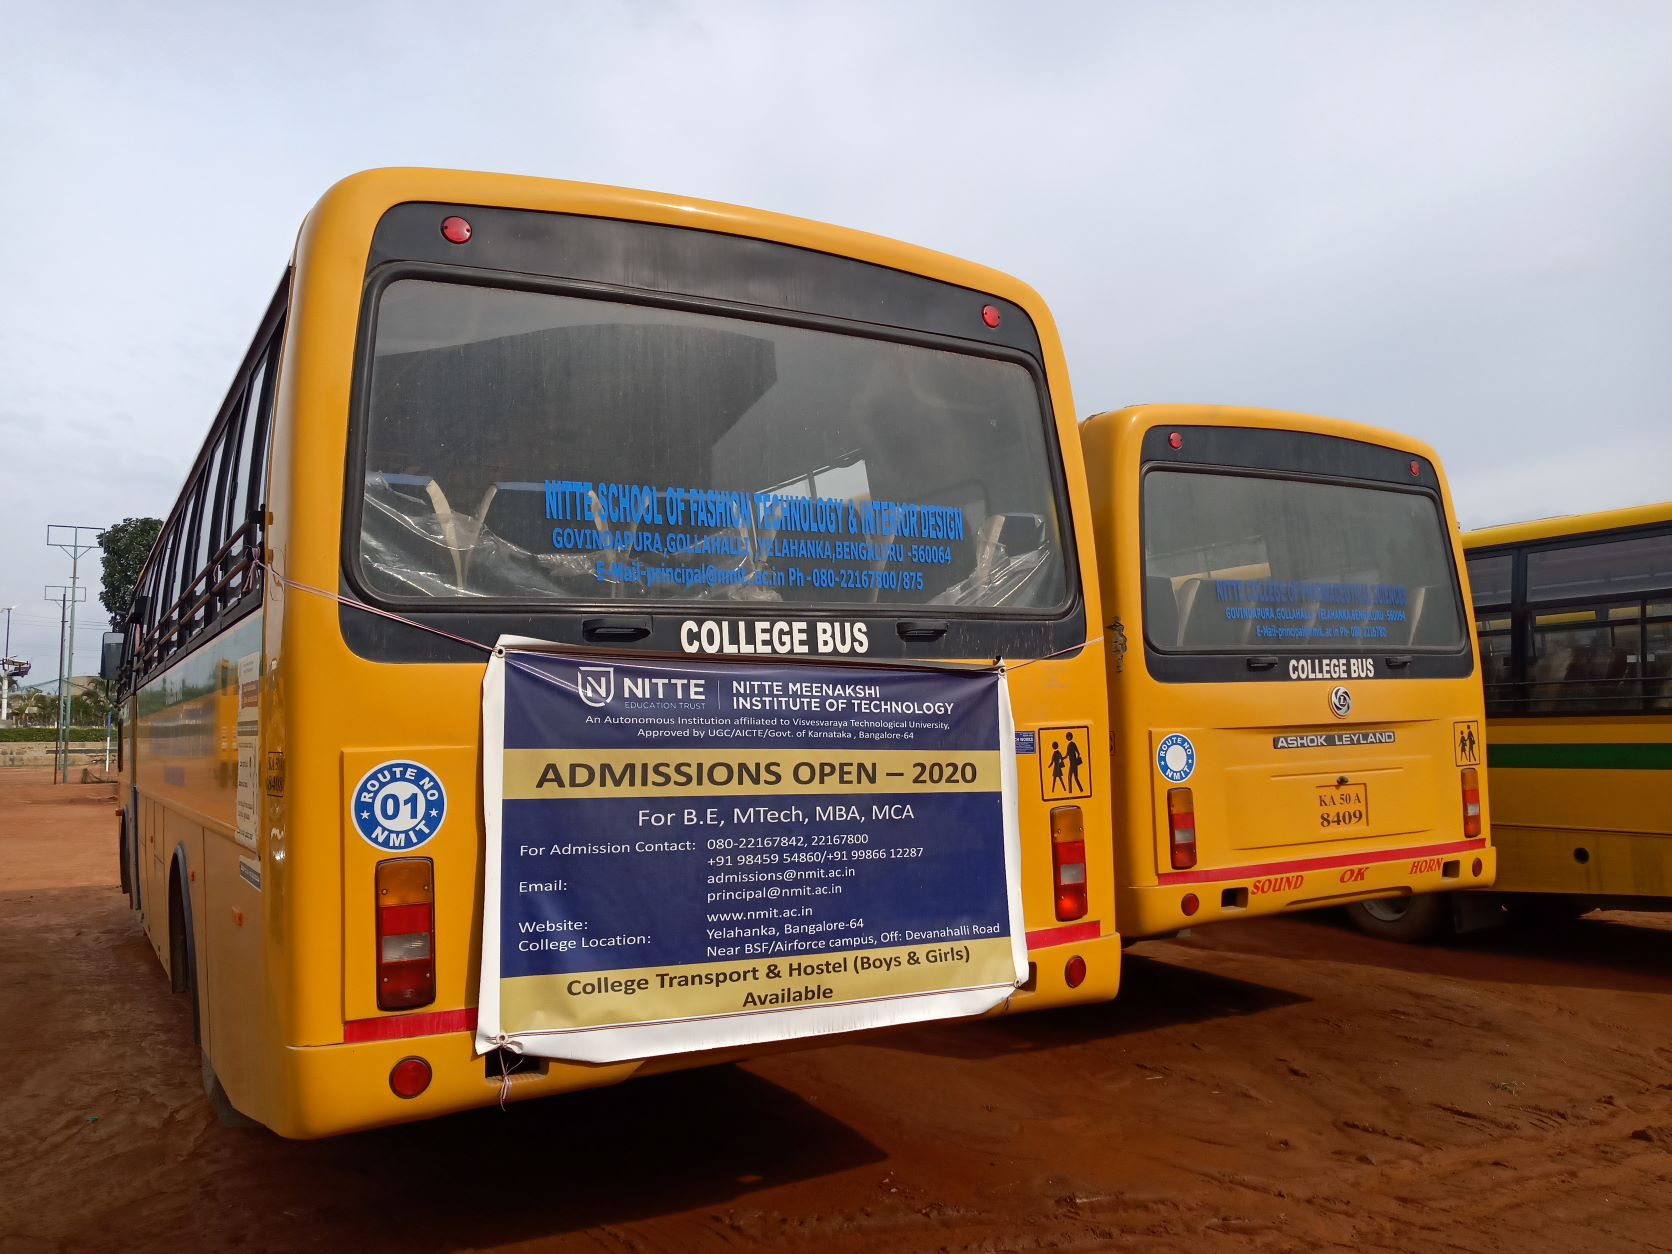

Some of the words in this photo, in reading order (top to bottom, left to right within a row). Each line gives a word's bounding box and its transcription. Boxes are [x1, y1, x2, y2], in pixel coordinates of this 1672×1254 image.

[545, 480, 593, 521] NITTE
[599, 482, 663, 525] SCHOOL
[666, 487, 685, 526] OF
[690, 488, 750, 529] FASHION
[754, 492, 843, 533] TECHNOLOGY
[848, 498, 858, 534] &
[861, 499, 918, 538] INTERIOR
[921, 505, 964, 541] DESIGN
[680, 620, 809, 654] COLLEGE
[817, 622, 870, 654] BUS
[1289, 658, 1348, 679] COLLEGE
[1350, 658, 1375, 678] BUS
[623, 677, 706, 700] NITTE
[732, 681, 783, 695] NITTE
[788, 683, 880, 698] MEENAKSHI
[624, 702, 677, 710] EDUCATION
[679, 702, 706, 710] TRUST
[733, 697, 821, 711] INSTITUTE
[826, 699, 847, 712] OF
[852, 700, 954, 715] TECHNOLOGY
[585, 716, 600, 724] An
[604, 716, 675, 725] Autonomous
[678, 716, 731, 725] Institution
[734, 716, 777, 726] affiliated
[780, 718, 790, 726] to
[792, 718, 848, 727] Visvesvaraya
[850, 719, 907, 729] Technological
[909, 720, 950, 730] University,
[637, 728, 690, 738] Approved
[693, 728, 705, 739] by
[708, 729, 793, 738] UGC/AICTE/Govt.
[796, 730, 805, 738] of
[808, 730, 851, 739] Karnataka
[859, 731, 914, 741] Bangalore-64
[1277, 735, 1327, 748] ASHOK
[1335, 731, 1394, 745] LEYLAND
[1160, 737, 1182, 757] ROUTE
[1184, 742, 1192, 755] NO
[535, 761, 782, 789] ADMISSIONS
[792, 762, 878, 786] OPEN
[912, 761, 977, 784] 2020
[1166, 765, 1190, 780] NMIT
[361, 767, 417, 803] ROUTE
[418, 776, 439, 801] NO
[380, 793, 419, 820] 01
[1318, 794, 1336, 807] KA
[1339, 793, 1351, 806] 50
[1352, 792, 1362, 804] A
[638, 809, 676, 826] For
[683, 808, 725, 828] B.E,
[733, 806, 809, 825] MTech,
[815, 806, 865, 823] MBA,
[872, 805, 915, 820] MCA
[1320, 809, 1363, 828] 8409
[371, 820, 430, 847] NMIT
[520, 845, 545, 856] For
[550, 843, 630, 856] Admission
[635, 840, 696, 852] Contact:
[707, 836, 808, 849] 080-22167842,
[811, 834, 869, 846] 22167800
[707, 855, 733, 866] +91
[737, 853, 779, 866] 98459
[783, 851, 848, 864] 54860/+91
[851, 849, 886, 860] 99866
[889, 847, 924, 858] 12287
[519, 880, 567, 893] Email:
[707, 867, 855, 884] admissions@nmit.ac.in
[1250, 875, 1304, 896] SOUND
[1339, 867, 1369, 883] OK
[1410, 857, 1443, 875] HORN
[707, 884, 842, 903] principal@nmit.ac.in
[518, 919, 588, 933] Website:
[707, 906, 813, 922] www.nmit.ac.in
[707, 924, 780, 940] Yelahanka,
[784, 918, 864, 935] Bangalore-64
[518, 938, 577, 952] College
[581, 934, 651, 948] Location:
[707, 945, 741, 957] Near
[745, 939, 826, 954] BSF/Airforce
[829, 935, 878, 949] campus,
[881, 932, 902, 943] Off:
[905, 924, 970, 941] Devanahalli
[972, 923, 1000, 934] Road
[567, 976, 649, 996] College
[656, 966, 759, 989] Transport
[765, 963, 782, 980] &
[788, 957, 848, 978] Hostel
[853, 954, 902, 974] (Boys
[906, 951, 921, 966] &
[925, 945, 970, 964] Girls)
[742, 984, 834, 1008] Available
